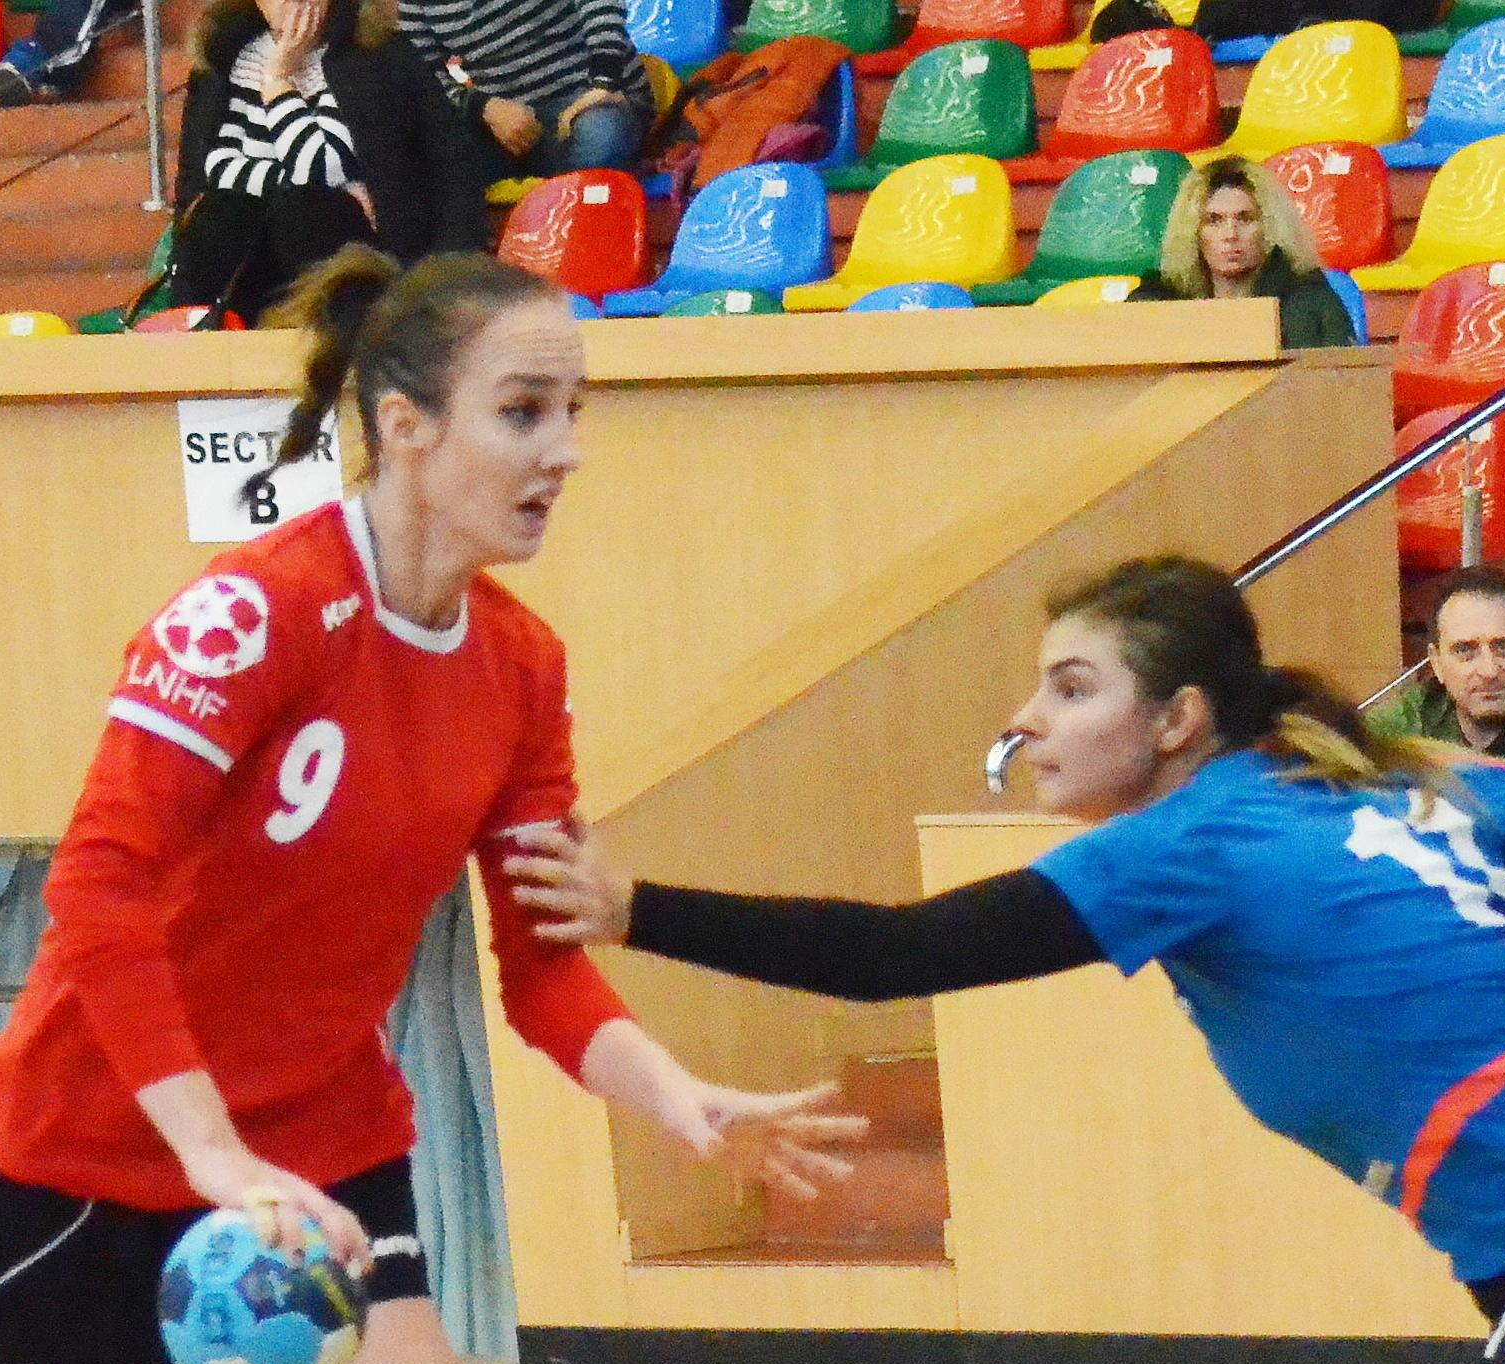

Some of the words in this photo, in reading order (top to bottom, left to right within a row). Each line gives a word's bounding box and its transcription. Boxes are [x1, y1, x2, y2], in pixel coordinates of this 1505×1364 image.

[186, 431, 335, 464] SECTR
[249, 481, 280, 525] B
[126, 655, 229, 719] LNHF
[263, 718, 346, 844] 9
